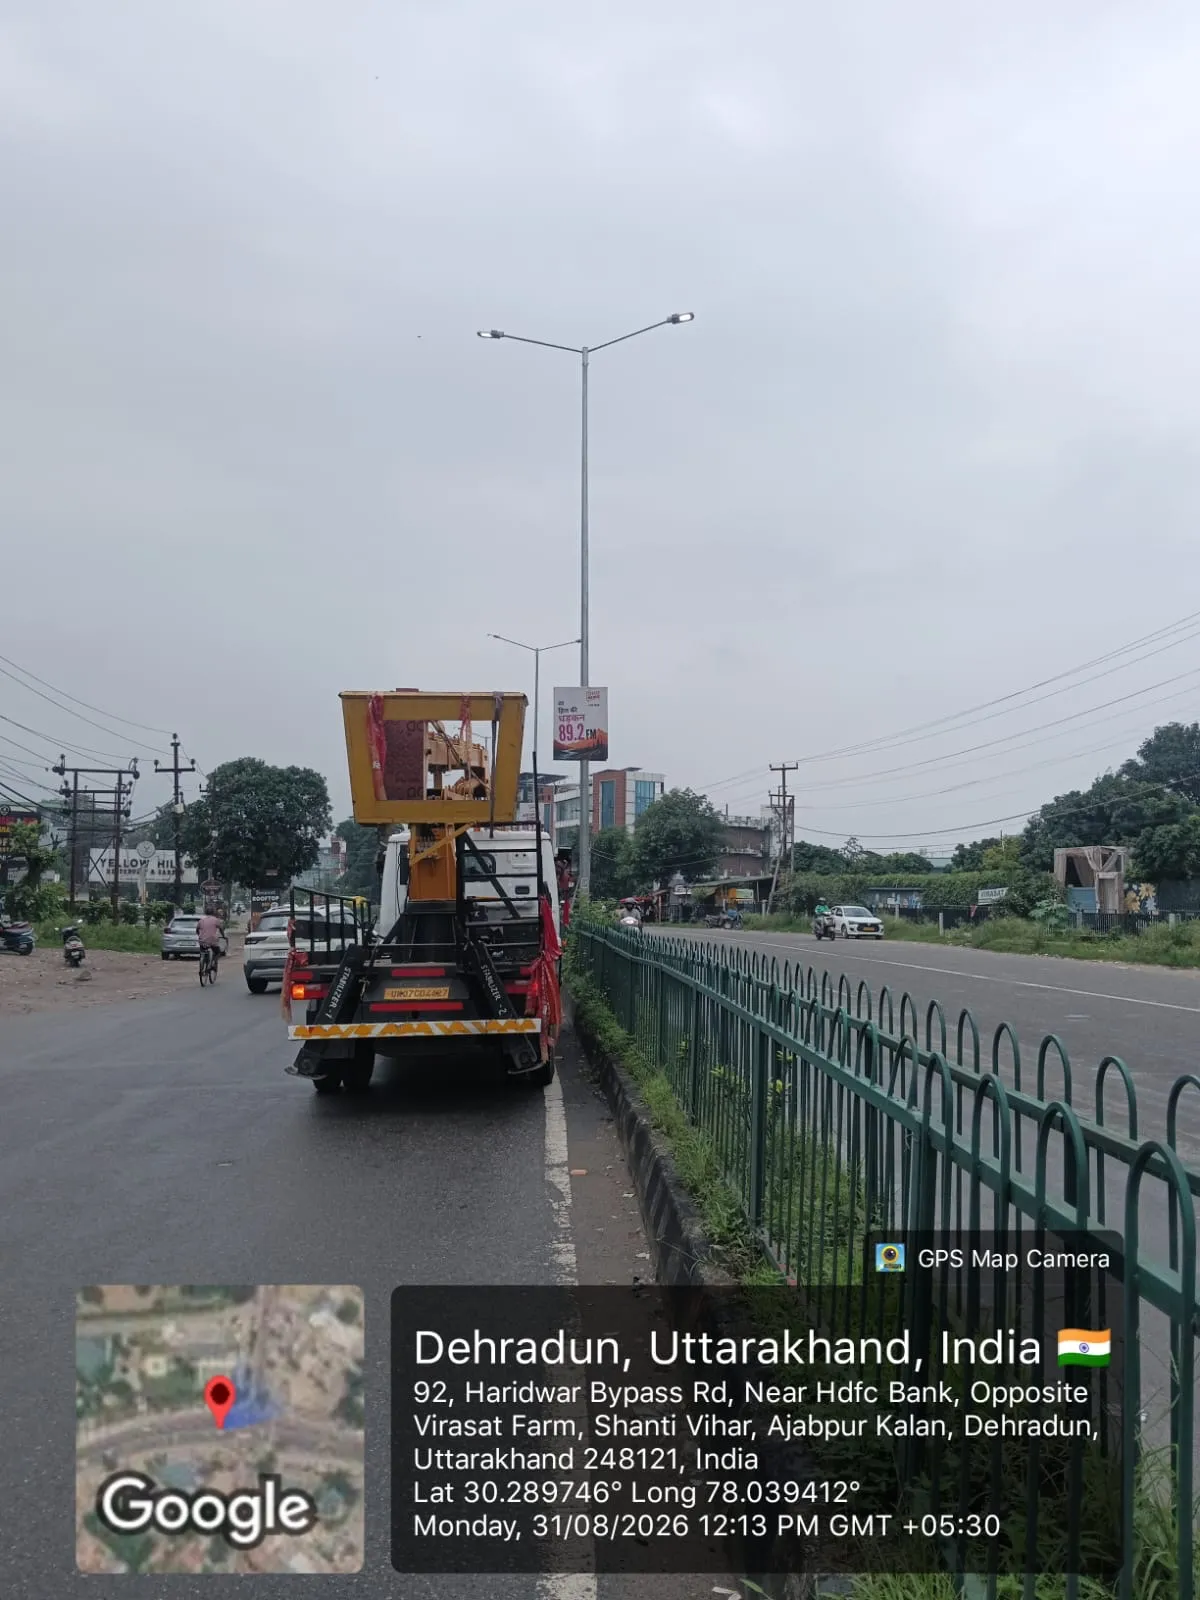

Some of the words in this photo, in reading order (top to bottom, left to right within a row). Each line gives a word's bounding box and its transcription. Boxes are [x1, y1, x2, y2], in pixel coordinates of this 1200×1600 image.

[558, 723, 585, 741] 89.2
[585, 728, 597, 740] FM
[328, 966, 352, 1009] STABILIZER
